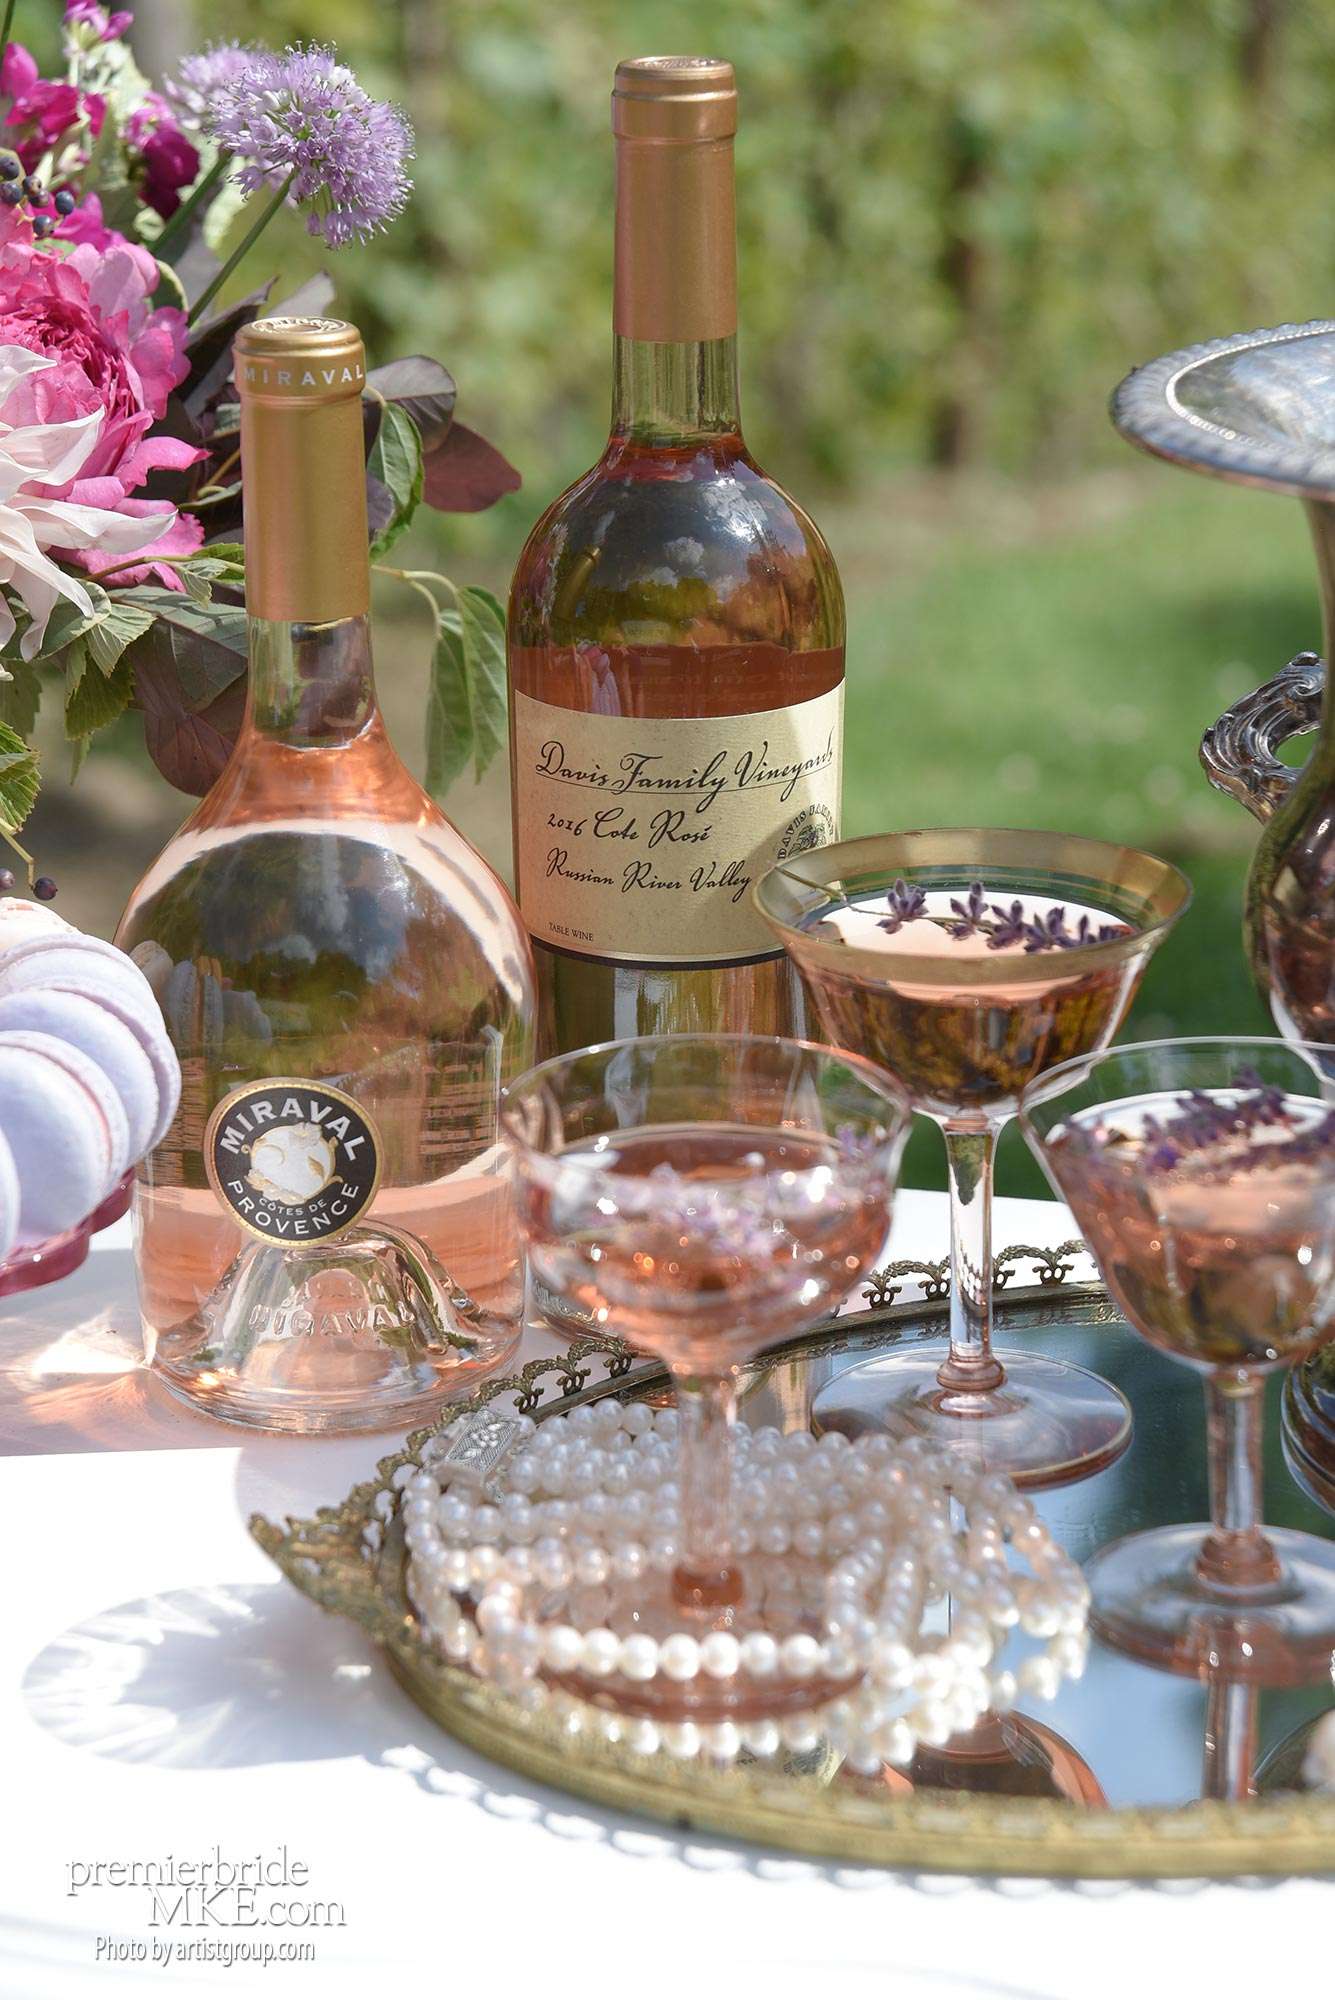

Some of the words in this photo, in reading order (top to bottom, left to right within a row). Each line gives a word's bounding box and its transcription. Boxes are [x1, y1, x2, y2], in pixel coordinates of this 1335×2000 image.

[244, 364, 363, 386] MIRAVAL
[535, 741, 609, 787] Davis
[611, 751, 727, 812] Family
[547, 813, 585, 836] 2016
[593, 807, 640, 840] Cote
[648, 810, 712, 848] Rosé
[777, 811, 807, 859] DAVIS
[546, 848, 615, 885] Russian
[621, 861, 682, 893] River
[689, 860, 751, 903] Valley
[549, 921, 569, 936] TABLE
[571, 929, 594, 941] WINE
[220, 1098, 365, 1161] MIRAVAL
[227, 1180, 359, 1235] PROVENCE
[259, 1198, 304, 1216] CÔTES
[309, 1198, 327, 1212] DE
